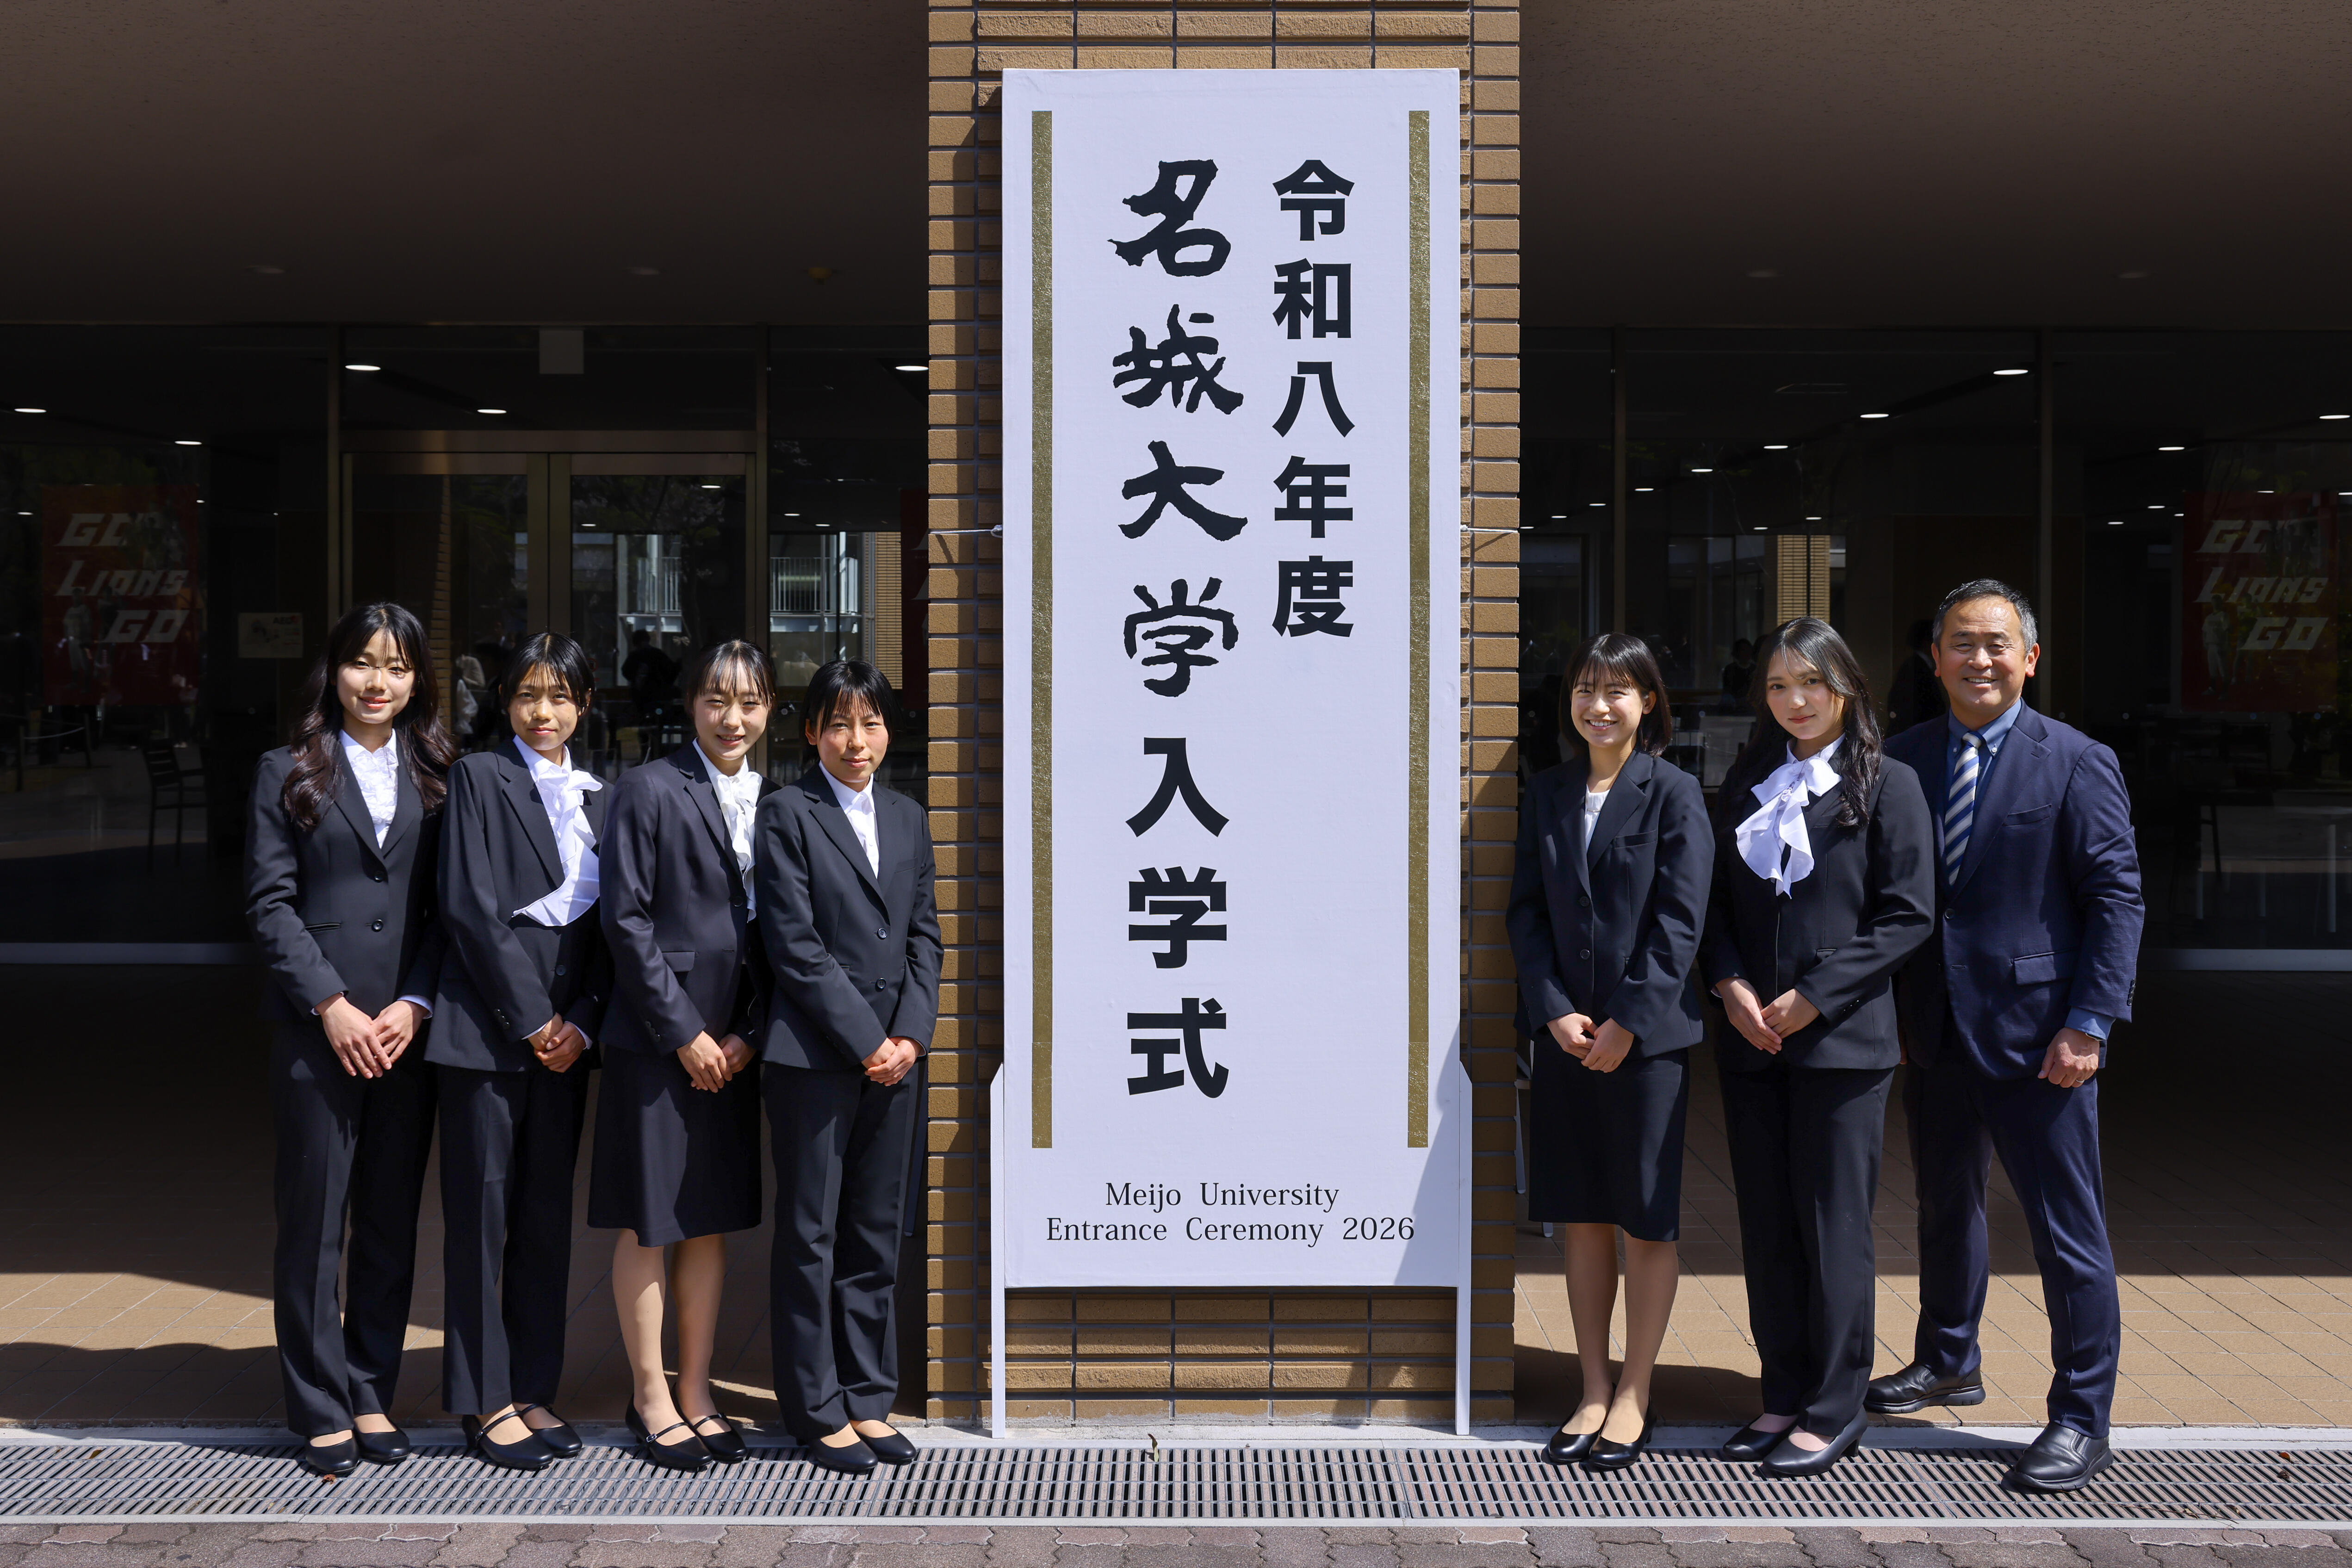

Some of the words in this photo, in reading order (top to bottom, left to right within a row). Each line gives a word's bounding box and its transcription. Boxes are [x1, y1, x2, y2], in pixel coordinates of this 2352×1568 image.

[1272, 160, 1355, 638] 令和八年度
[99, 609, 190, 643] GO
[1107, 159, 1248, 1098] 名城大学入学式
[2237, 616, 2329, 651] GO
[1105, 1183, 1181, 1213] Meijo
[1200, 1183, 1340, 1213] University
[1047, 1218, 1167, 1240] Entrance
[1186, 1217, 1324, 1248] Ceremony
[1343, 1217, 1415, 1240] 2026
